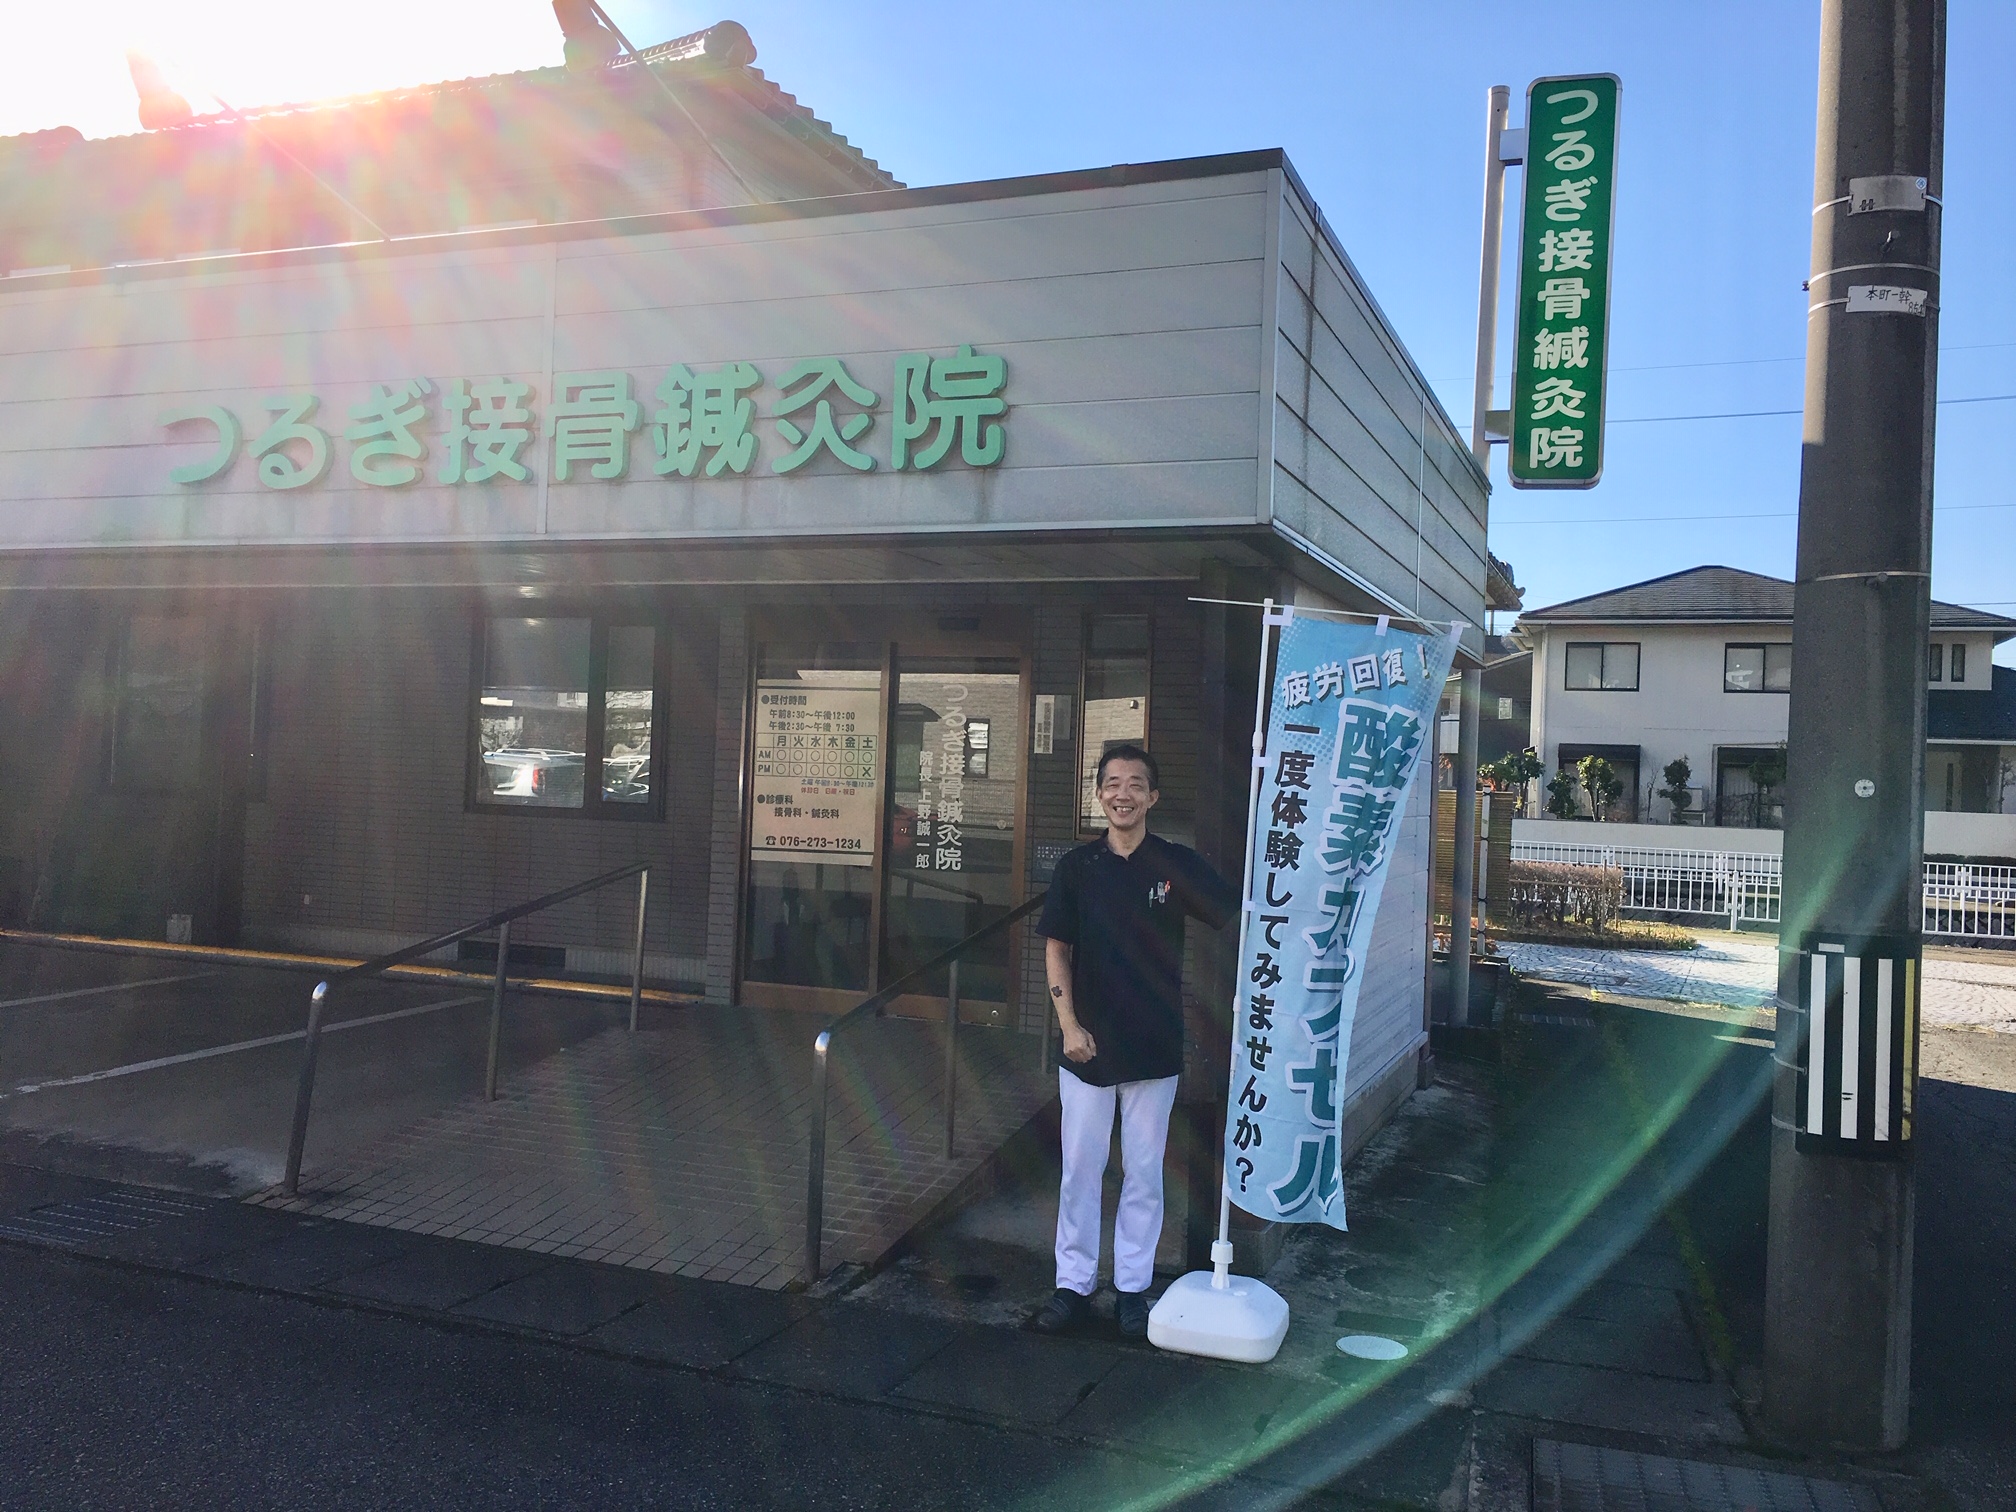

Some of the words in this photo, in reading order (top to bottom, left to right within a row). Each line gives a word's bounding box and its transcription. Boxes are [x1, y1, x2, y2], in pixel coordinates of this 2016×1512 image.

[158, 343, 1009, 489] つるぎ接骨鍼灸院
[769, 694, 807, 706] 受付時間
[776, 735, 787, 747] 月
[793, 735, 804, 748] 火
[810, 736, 822, 748] 水
[827, 736, 839, 748] 木
[844, 736, 856, 749] 金
[862, 737, 873, 749] 土
[758, 750, 771, 759] AM
[757, 764, 771, 773] PM
[919, 751, 934, 783] 院長
[934, 684, 969, 871] つるぎ接骨鍼灸院
[915, 788, 933, 869] 上野誠一郎
[779, 836, 862, 850] 076-273-1234
[1231, 723, 1321, 1193] 一度体験してみませんか？
